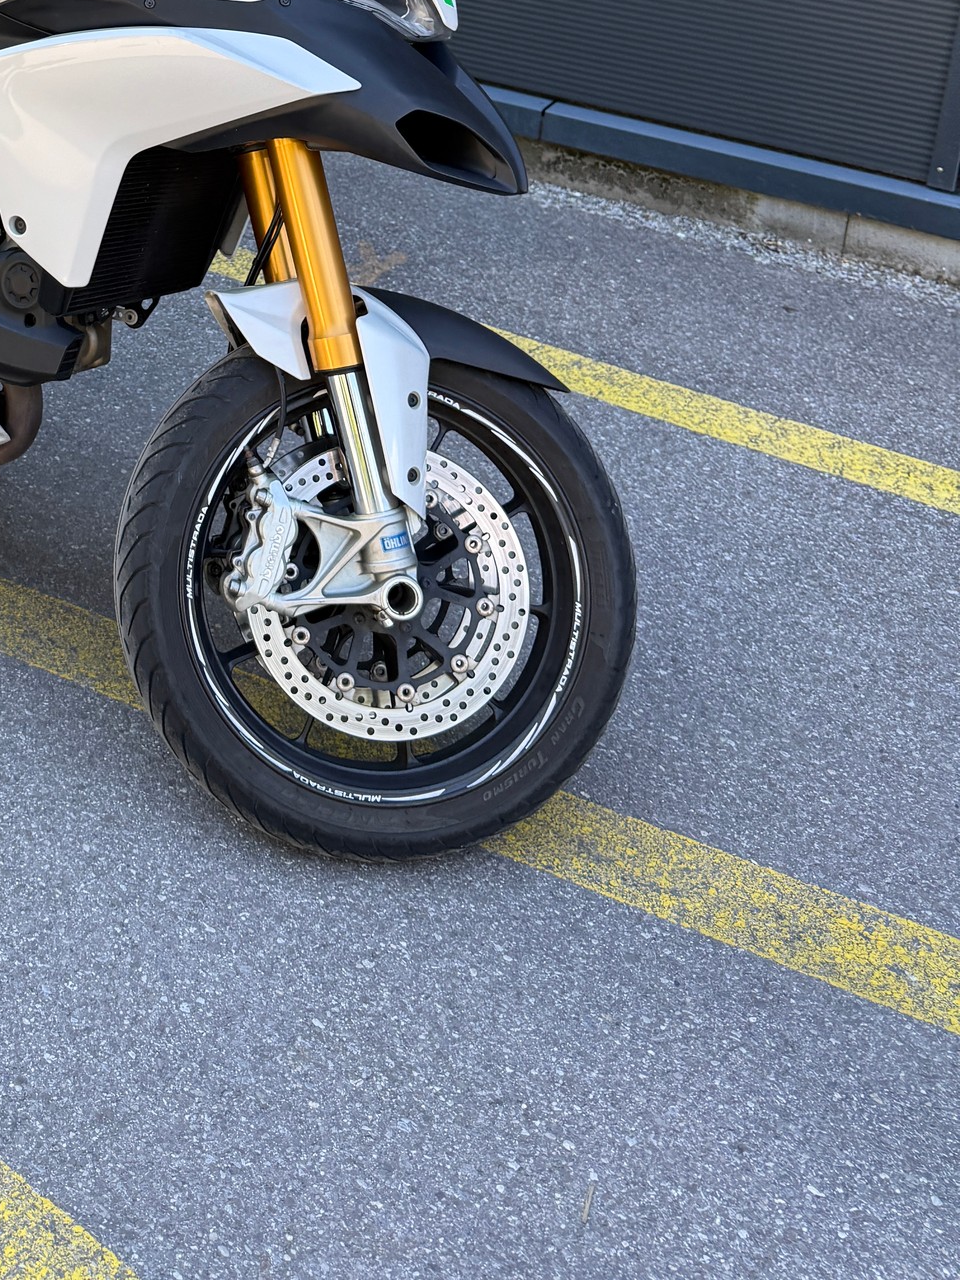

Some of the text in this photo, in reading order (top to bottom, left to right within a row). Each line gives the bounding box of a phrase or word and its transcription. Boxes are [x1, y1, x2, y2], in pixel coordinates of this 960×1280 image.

[185, 506, 209, 600] MULTISTRADA
[259, 524, 285, 580] brembo
[555, 600, 582, 694] MULTISTRADA
[292, 770, 382, 803] MULTISTRADA
